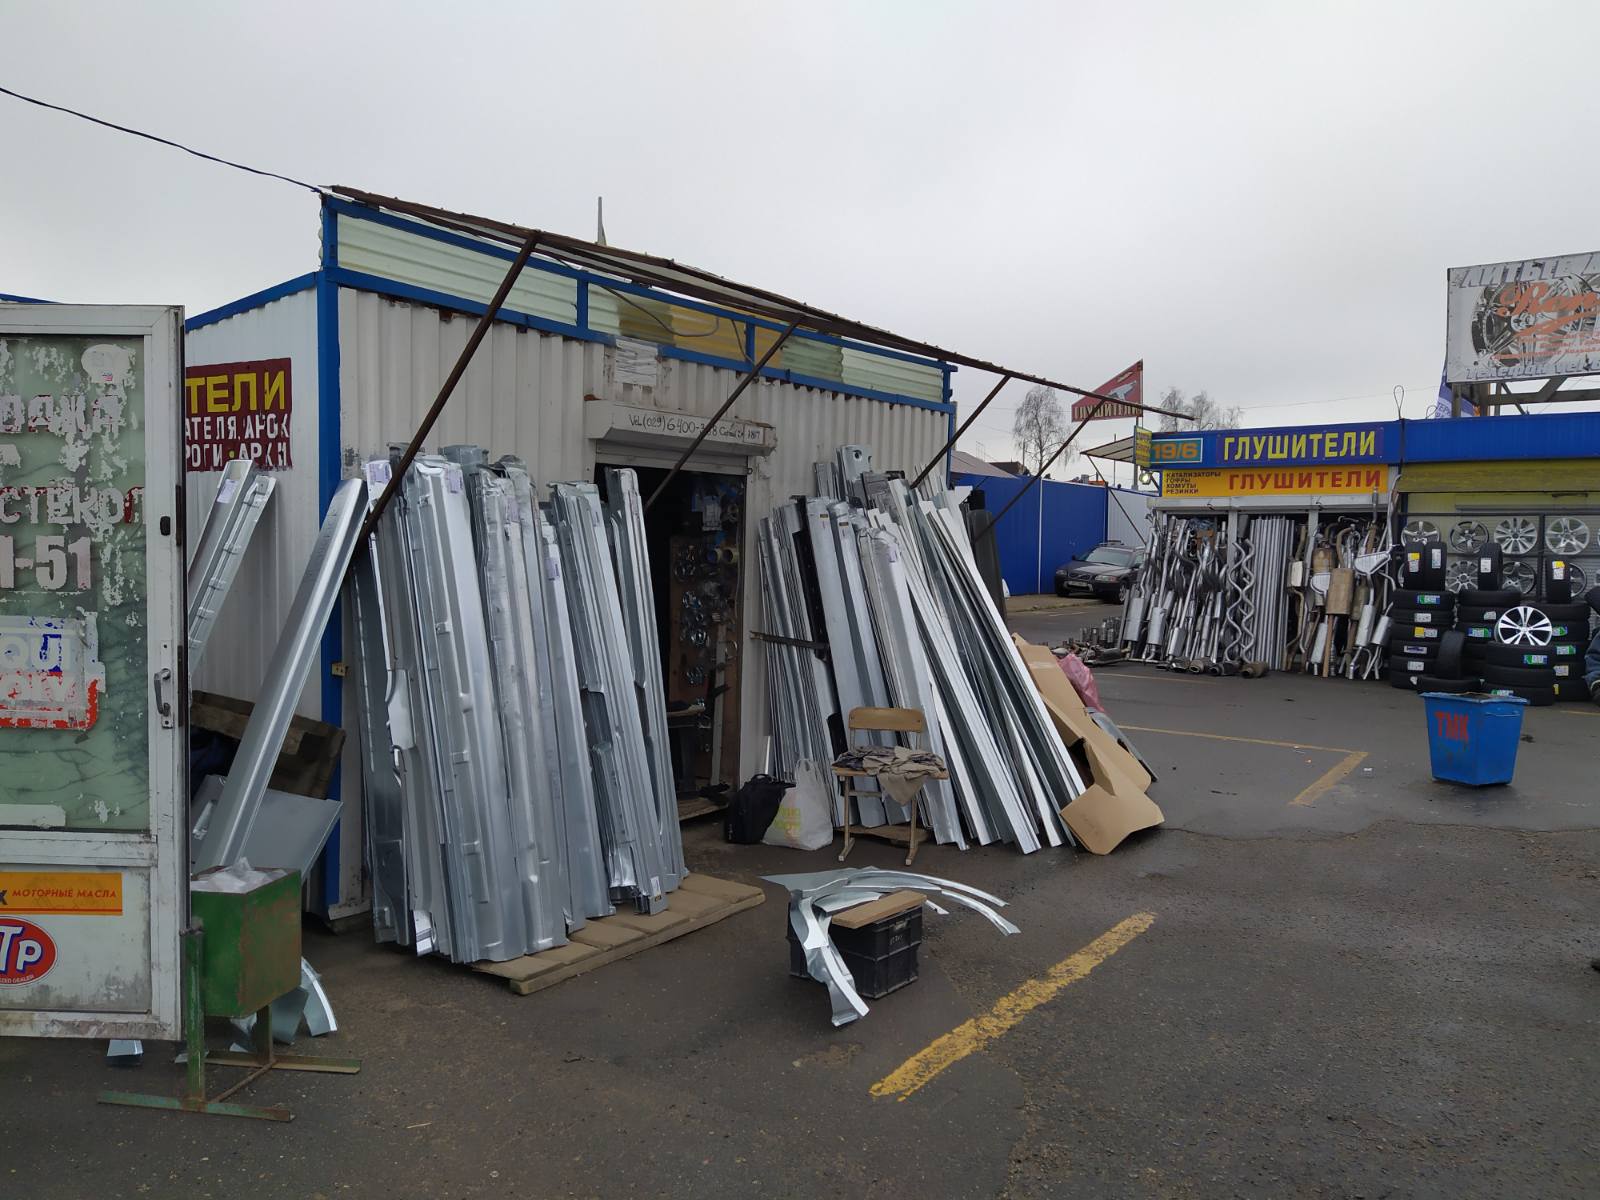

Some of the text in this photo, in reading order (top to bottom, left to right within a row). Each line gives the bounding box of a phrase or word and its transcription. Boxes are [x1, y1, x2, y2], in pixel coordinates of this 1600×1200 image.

[186, 371, 286, 414] ТЕЛИ
[1154, 442, 1199, 460] 19/6
[1223, 430, 1376, 460] ГЛУШИТЕЛИ
[1229, 469, 1381, 490] ГЛУШИТЕЛИ
[12, 888, 74, 898] МОТОРНЫЕ
[76, 888, 117, 898] МАСЛА
